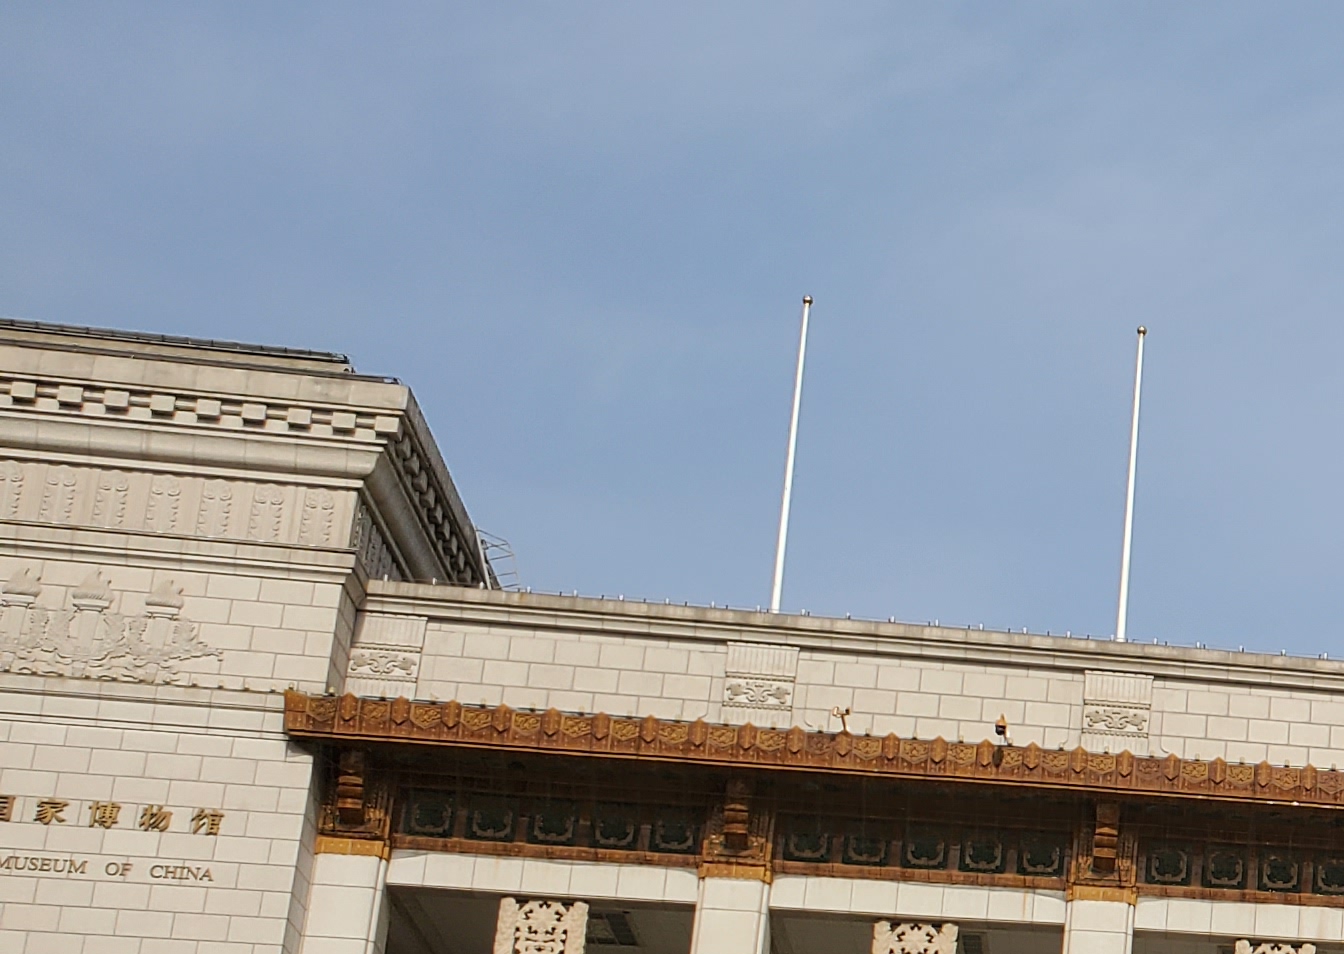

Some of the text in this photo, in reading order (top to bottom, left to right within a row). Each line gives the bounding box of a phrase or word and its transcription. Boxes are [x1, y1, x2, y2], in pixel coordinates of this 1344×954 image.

[0, 855, 214, 881] MUSEUM OF CHINA
